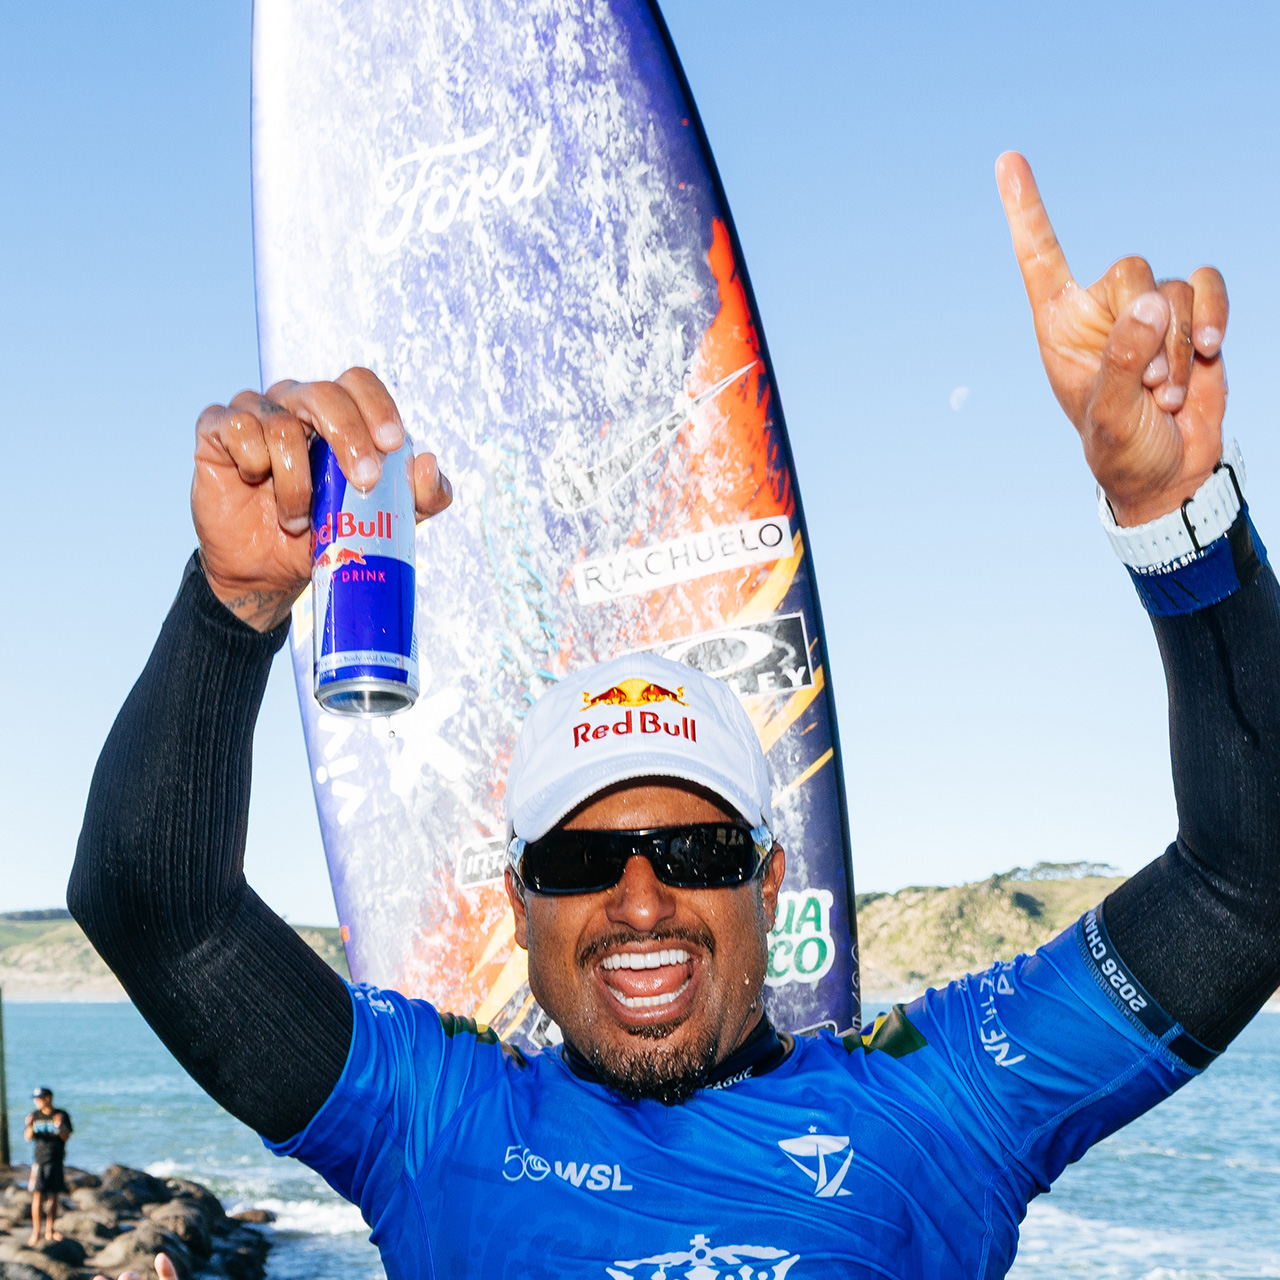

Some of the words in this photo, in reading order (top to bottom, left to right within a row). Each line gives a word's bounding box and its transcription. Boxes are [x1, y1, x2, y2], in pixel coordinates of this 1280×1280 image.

[368, 121, 556, 254] Ford
[336, 510, 392, 540] Bull
[342, 569, 386, 583] DRINK
[583, 523, 784, 592] RIACHUELO
[728, 665, 807, 697] LEY
[573, 710, 633, 748] Red
[639, 710, 697, 743] Bull
[316, 713, 369, 826] viv
[773, 896, 823, 936] UA
[767, 936, 828, 978] CO
[1101, 958, 1148, 1013] 2026
[555, 1161, 634, 1191] WSL
